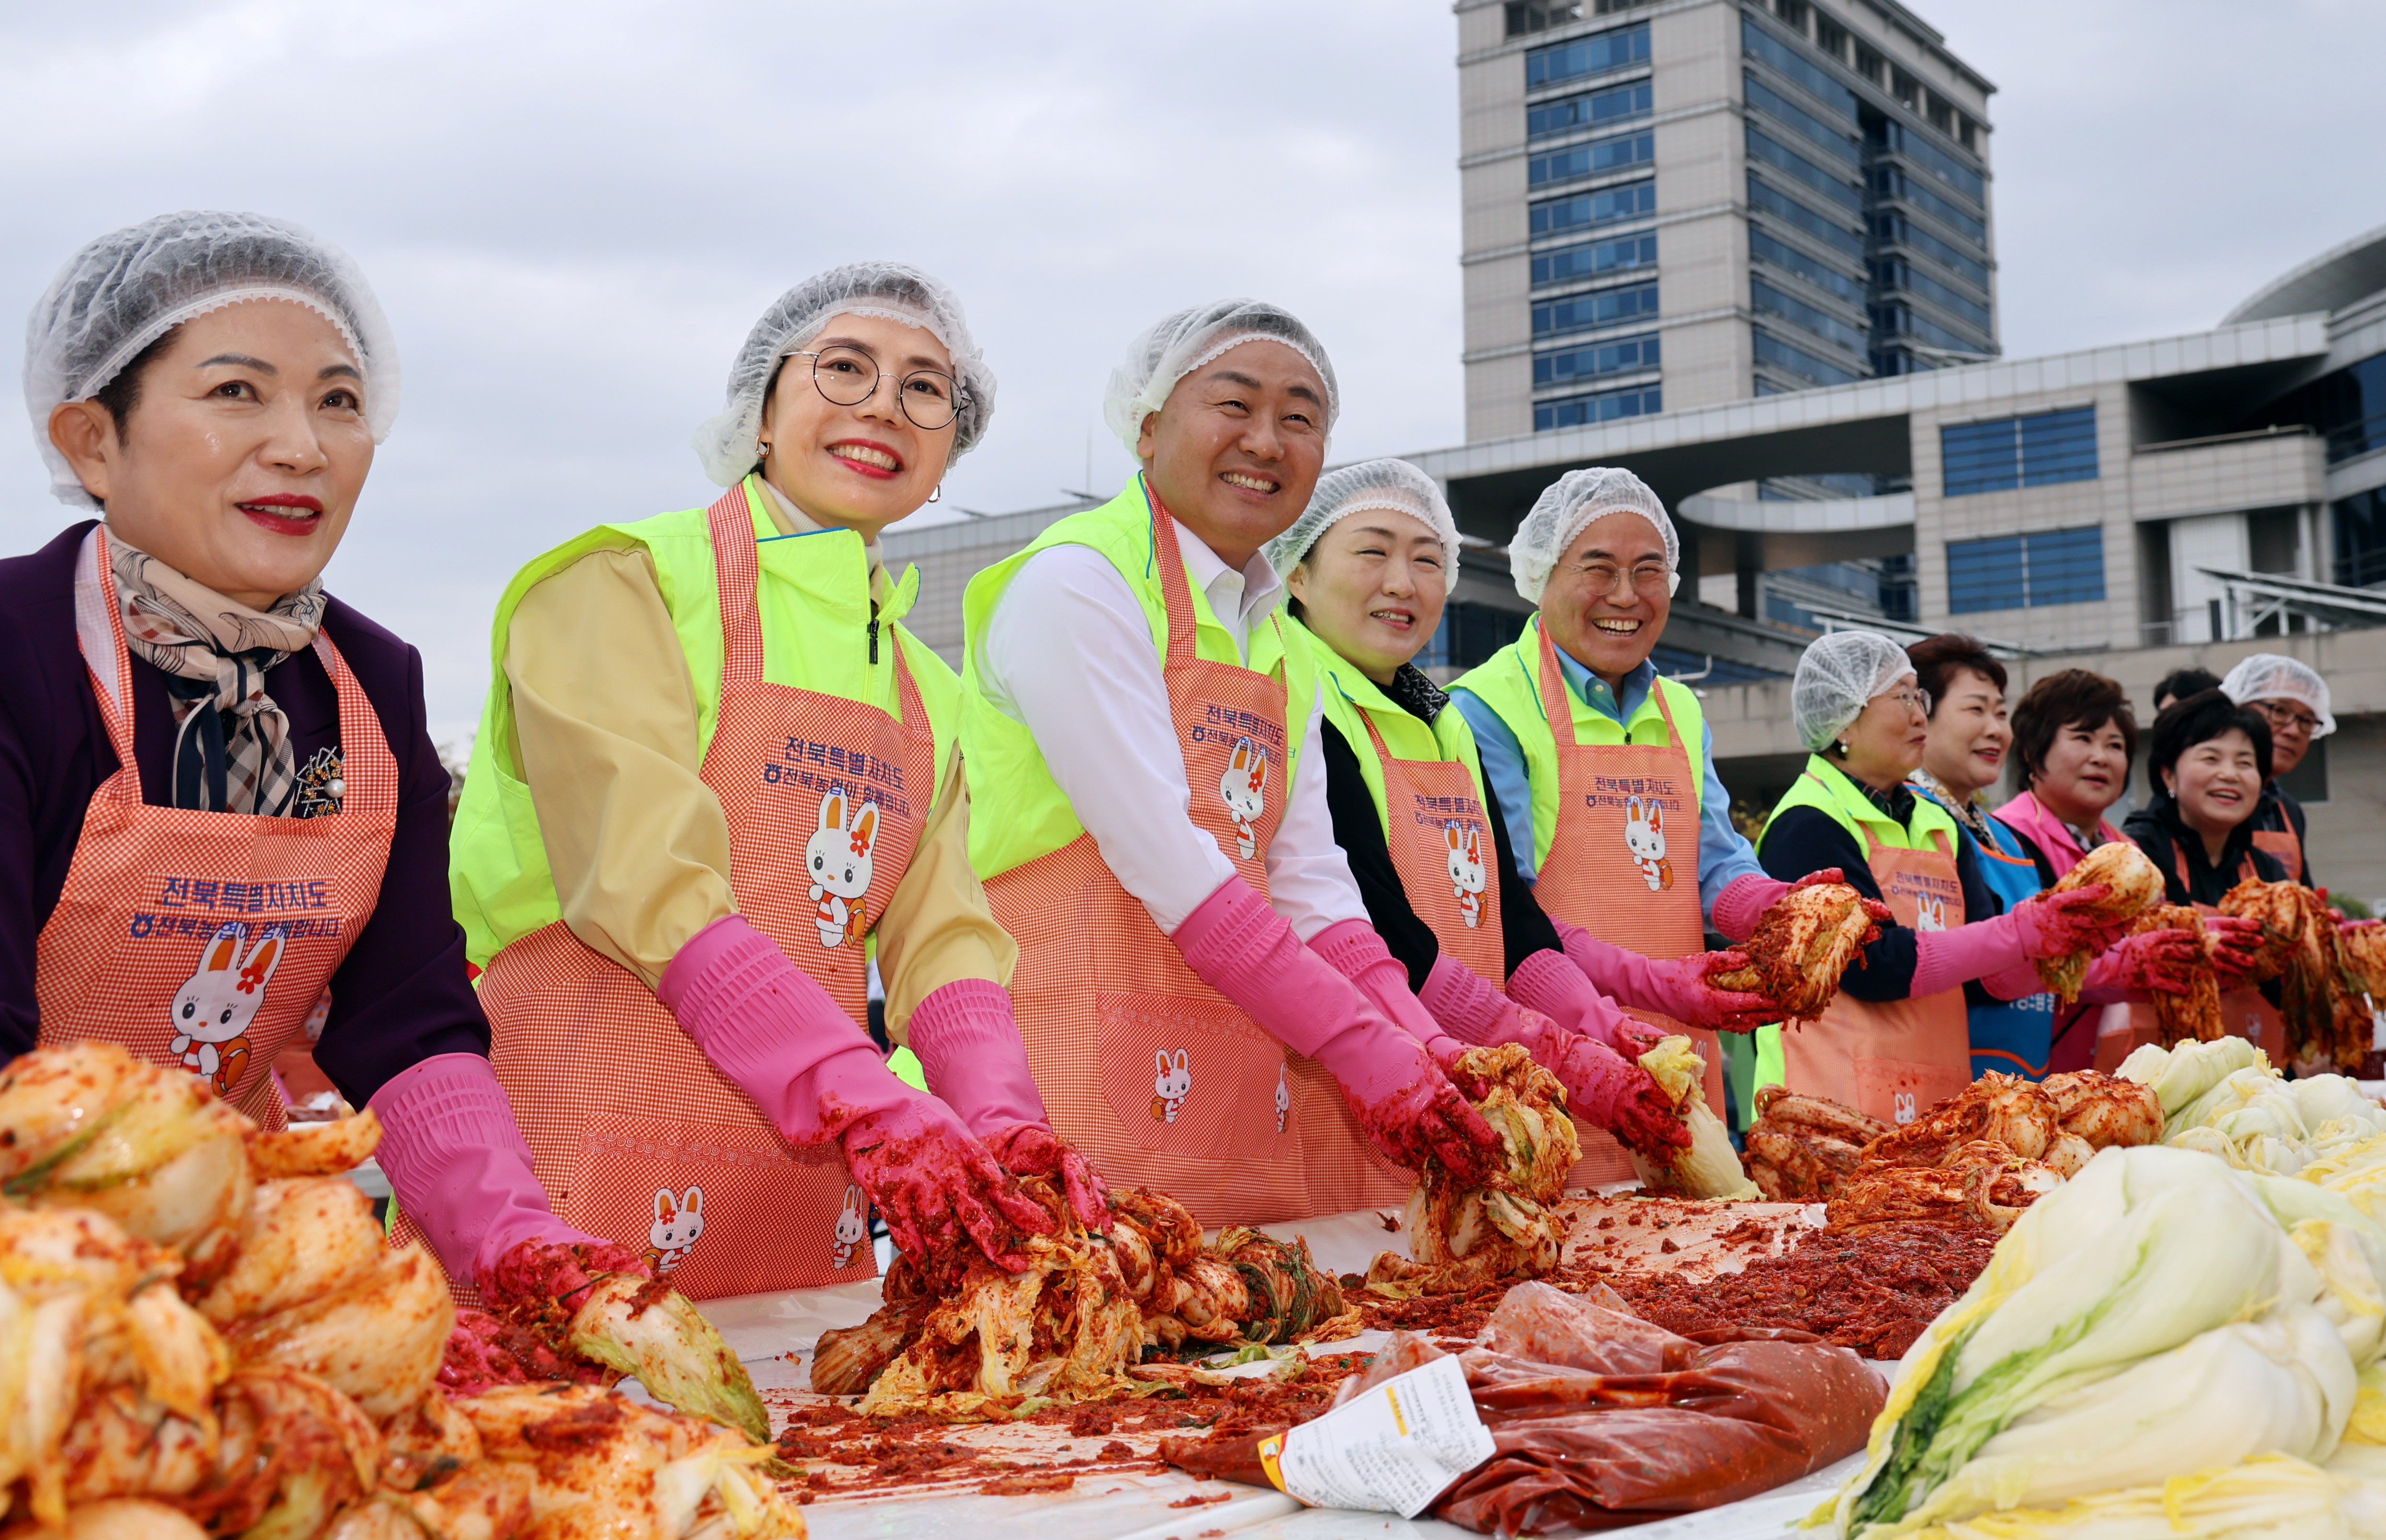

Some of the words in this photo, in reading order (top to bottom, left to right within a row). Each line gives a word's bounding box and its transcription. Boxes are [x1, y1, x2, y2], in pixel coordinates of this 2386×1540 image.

[1207, 705, 1284, 746] 전북특별자치도
[785, 736, 904, 791] 전북특별자치도
[784, 768, 857, 800] 전북농협이
[1595, 777, 1674, 795] 전북특별자치도
[162, 877, 327, 912] 전북특별자치도
[156, 916, 257, 941] 전북농협이
